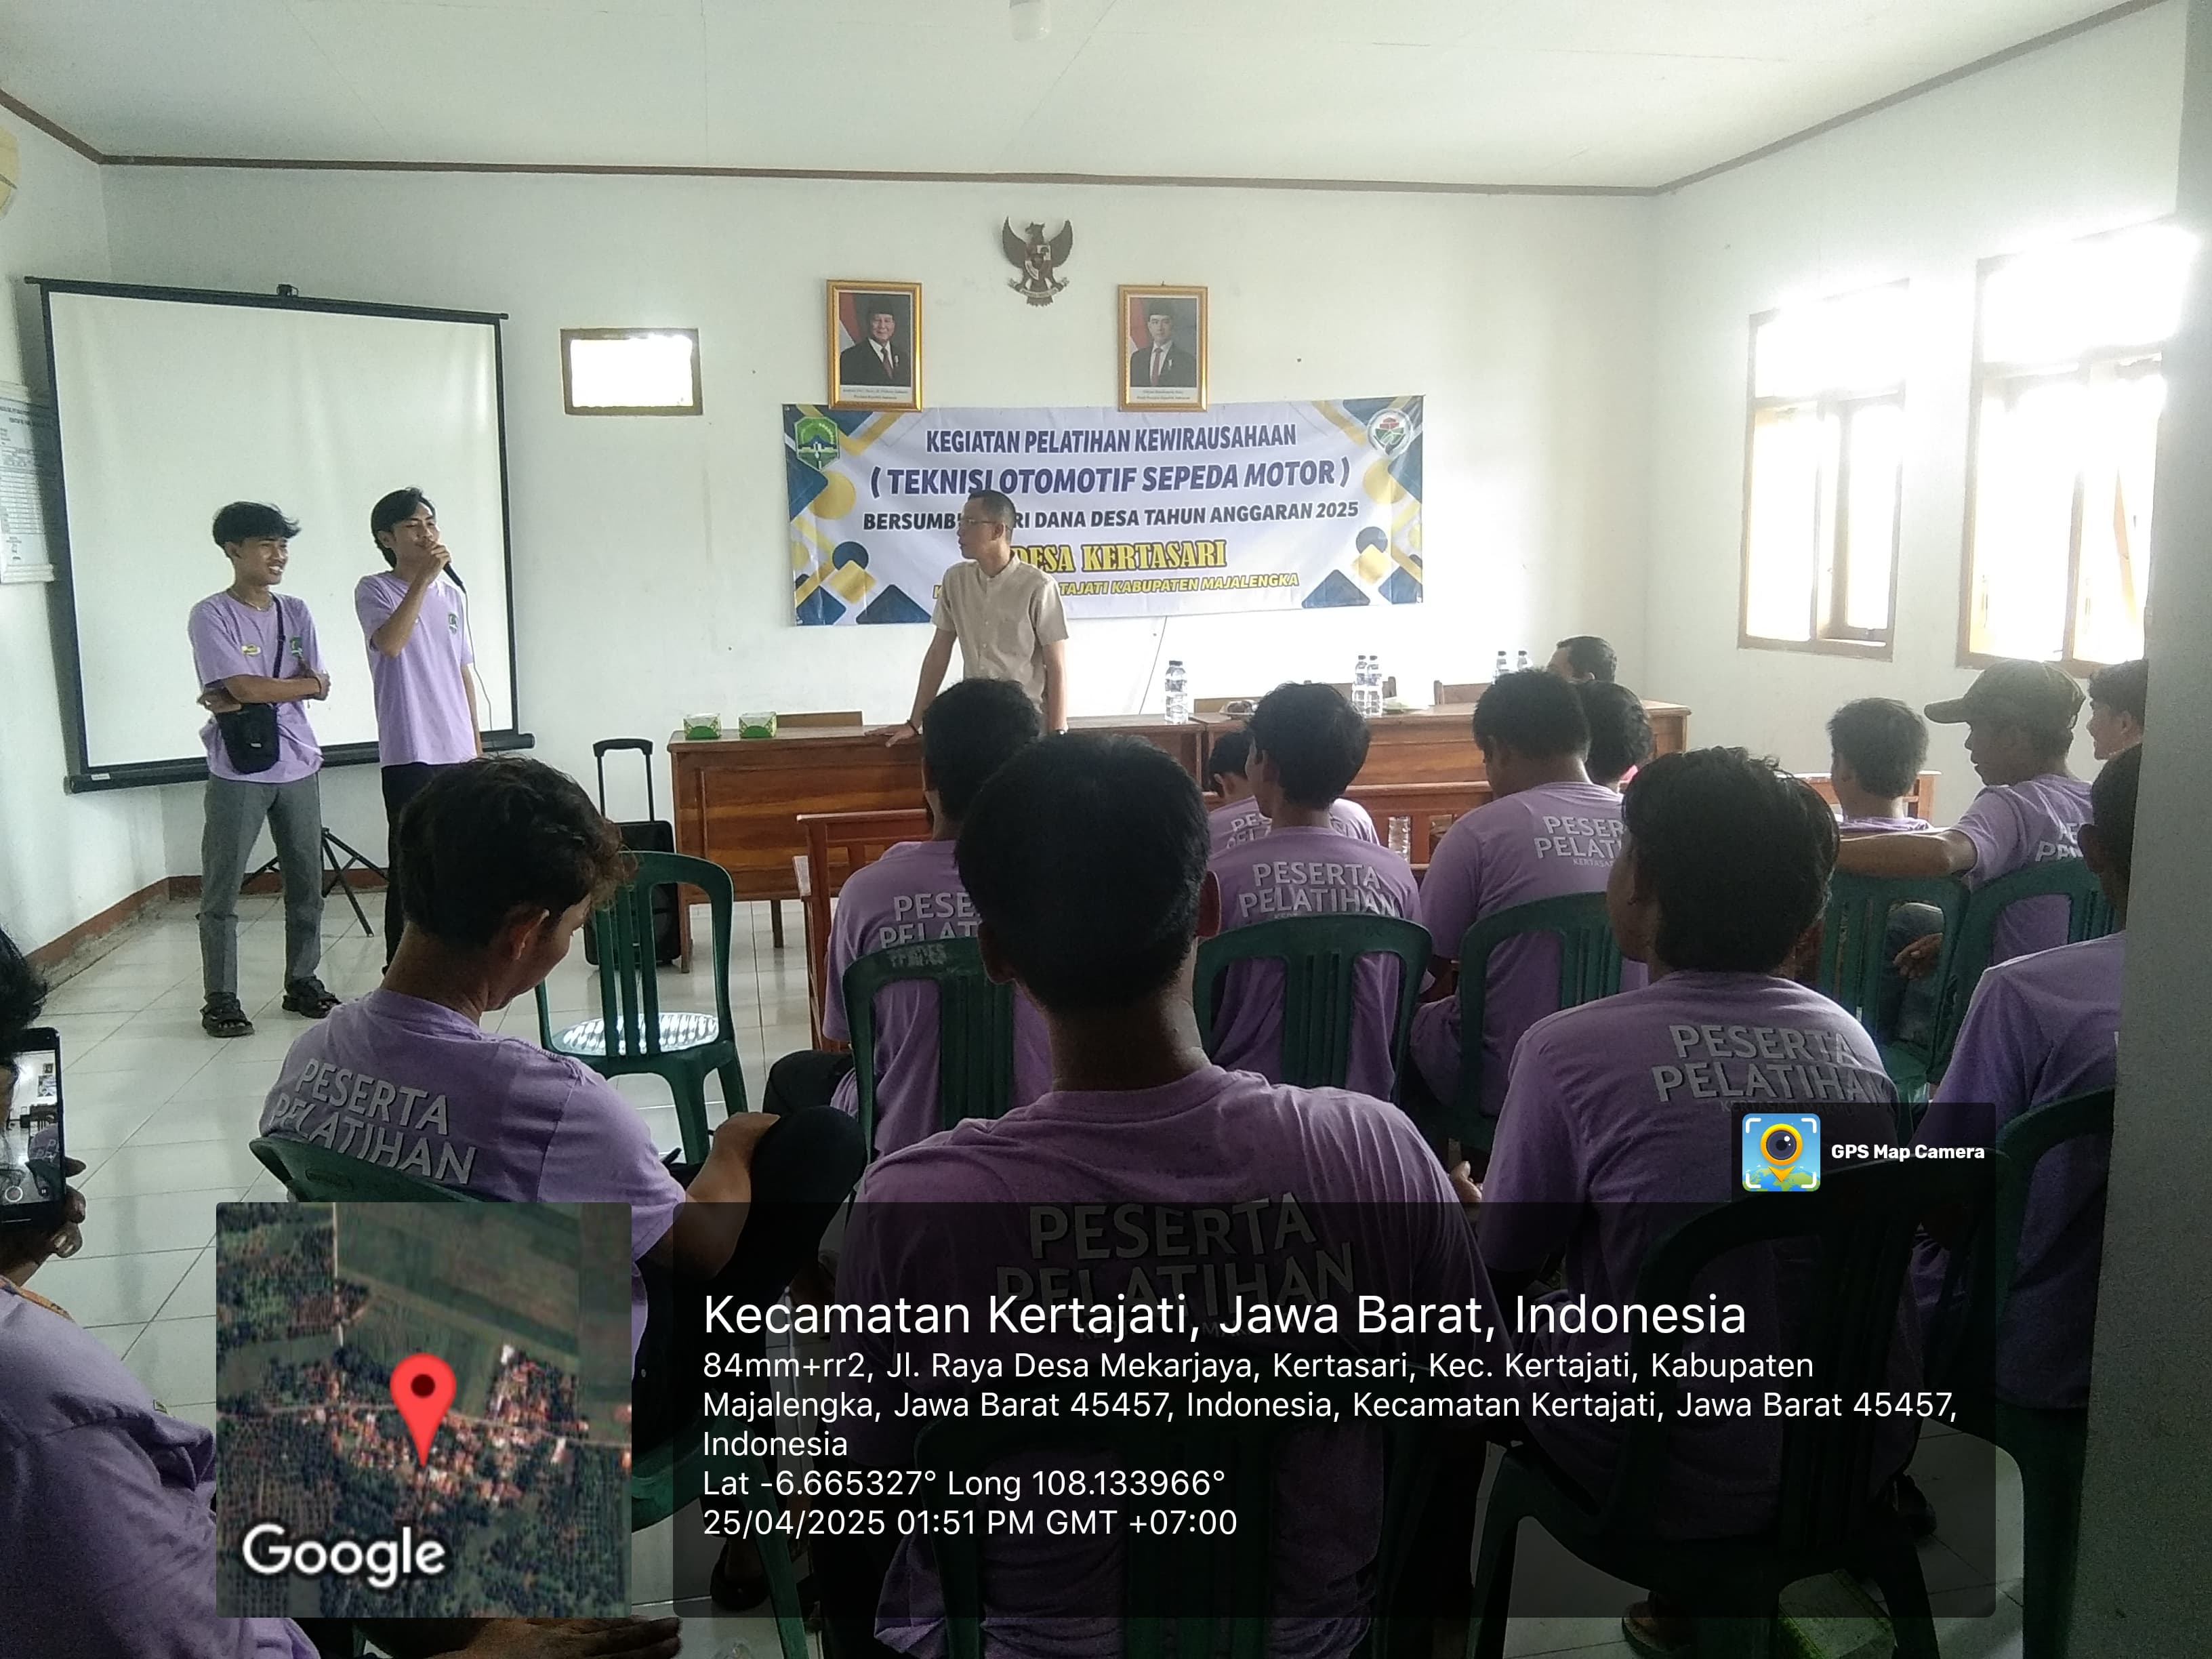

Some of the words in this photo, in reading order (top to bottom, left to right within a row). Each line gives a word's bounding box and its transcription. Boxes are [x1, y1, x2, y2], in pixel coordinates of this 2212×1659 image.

[926, 430, 1020, 453] KEGIATAN
[1024, 429, 1130, 453] PELATIHAN
[1134, 424, 1296, 452] KEWIRAUSAHAAN
[887, 468, 993, 495] TEKNISI
[999, 467, 1137, 494] OTOMOTIF
[1142, 464, 1239, 492] SEPEDA
[1244, 459, 1335, 489] MOTOR
[863, 512, 960, 530] BERSUMB
[1035, 510, 1086, 529] DANA
[1090, 509, 1140, 527] DESA
[1144, 507, 1206, 527] TAHUN
[1210, 502, 1313, 524] ANGGARAN
[1315, 501, 1359, 518] 2025
[1081, 539, 1227, 572] KERTASARI
[1059, 581, 1108, 596] TAJATI
[1111, 577, 1199, 594] KABUPATEN
[1202, 573, 1300, 591] MAJALENGKA
[1542, 815, 1624, 838] PESER
[1534, 836, 1622, 859] PELAT
[1252, 861, 1381, 889] PESERTA
[893, 892, 977, 922] PESE
[1238, 886, 1400, 918] PELATIHAN
[1669, 1024, 1864, 1068] PESERTA
[295, 1057, 449, 1136] PESERTA
[1651, 1061, 1889, 1107] PELATIHAN
[268, 1092, 478, 1185] PELATIHAN
[1029, 1192, 1317, 1259] PESERTA
[996, 1242, 1354, 1319] PELATIHAN
